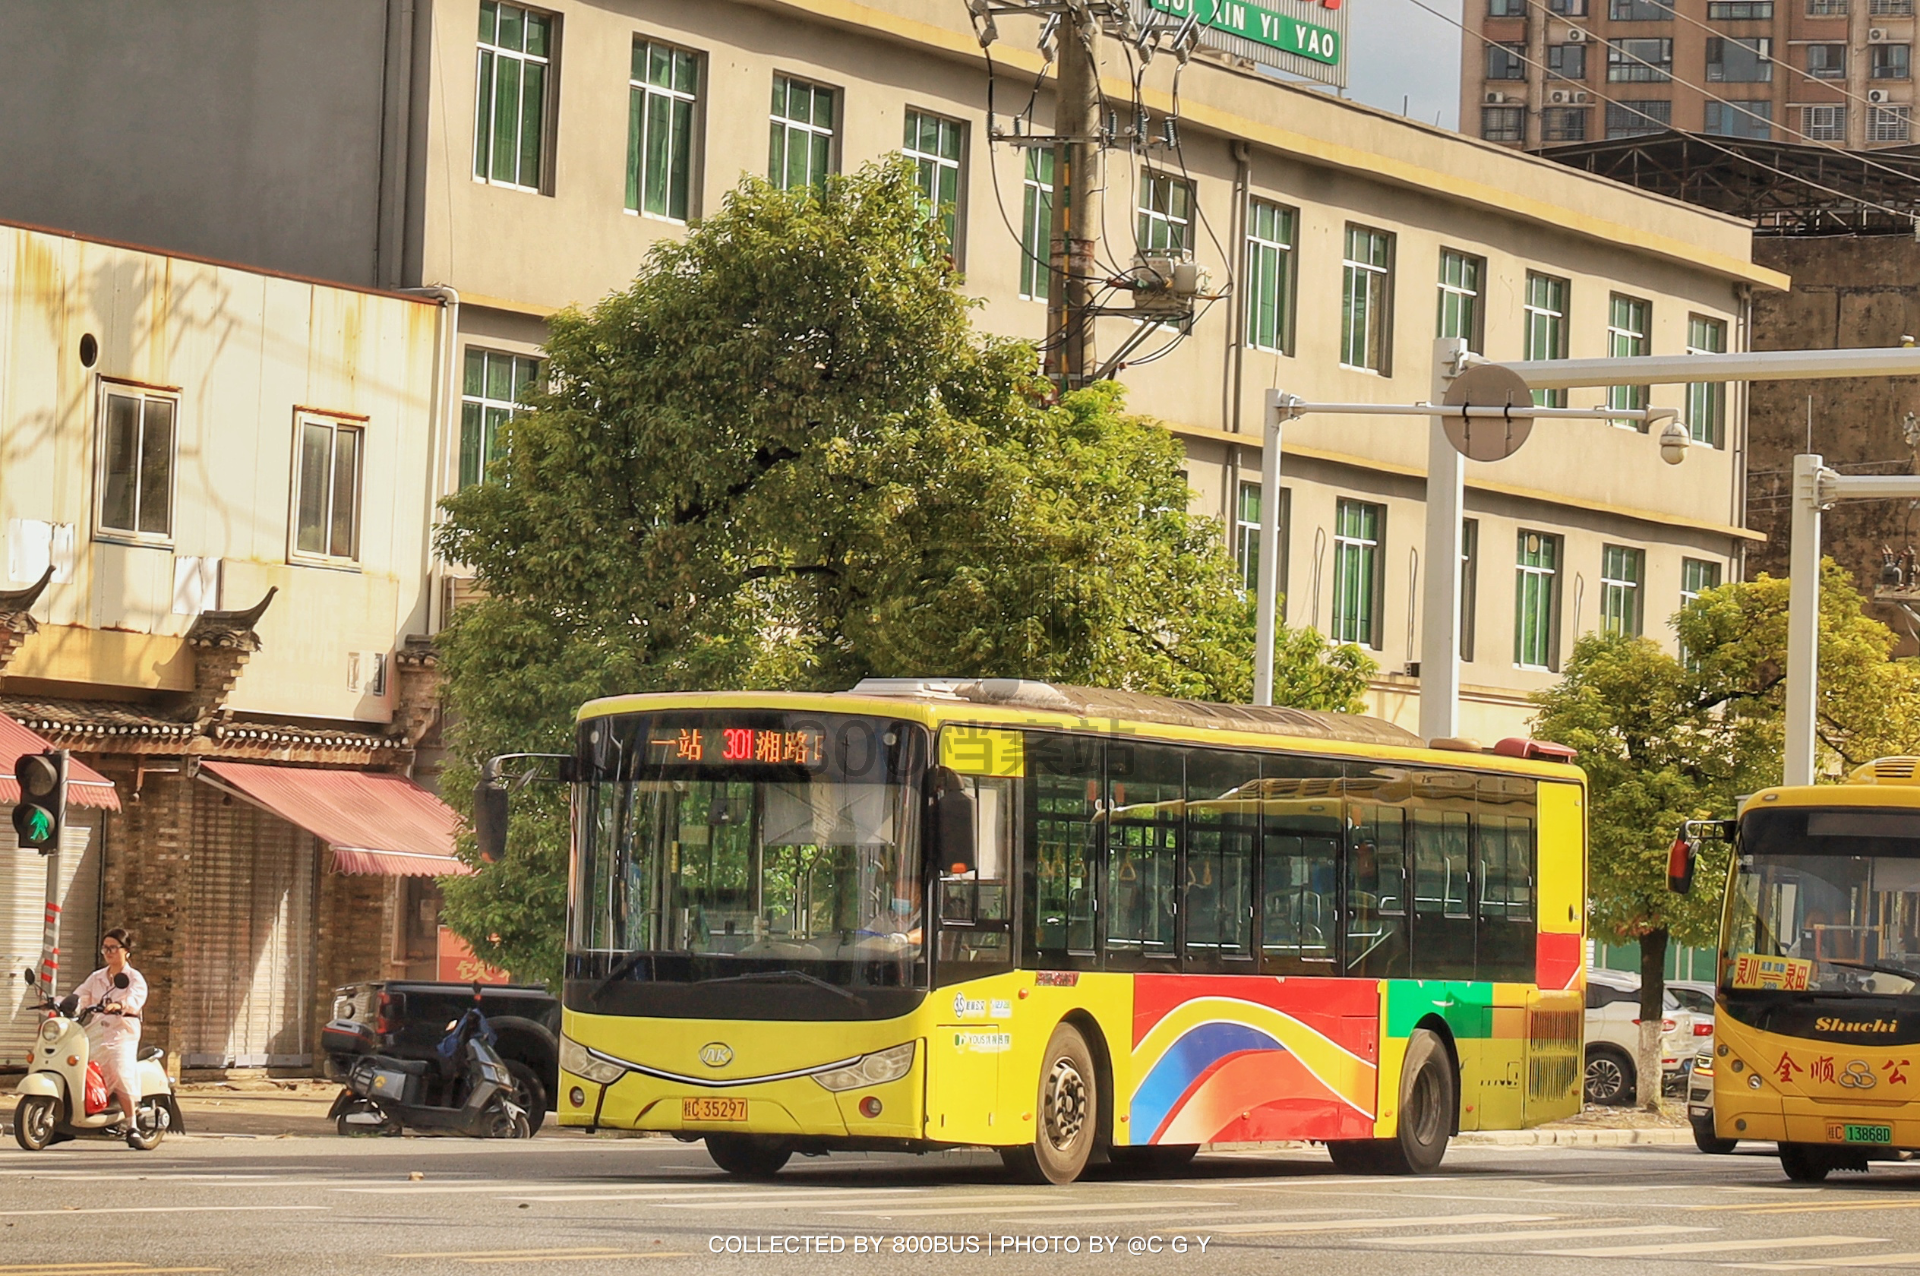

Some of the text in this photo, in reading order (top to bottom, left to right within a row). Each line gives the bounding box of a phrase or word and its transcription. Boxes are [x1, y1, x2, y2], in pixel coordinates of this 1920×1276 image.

[1211, 0, 1245, 31] XIN
[1259, 12, 1280, 42] YI
[1295, 24, 1335, 58] YAO
[650, 728, 704, 762] 一站
[722, 728, 754, 761] 301
[1735, 957, 1760, 987] 灵川
[1783, 963, 1808, 990] 灵田
[1814, 1016, 1898, 1033] Shuchi
[1881, 1059, 1911, 1085] 公
